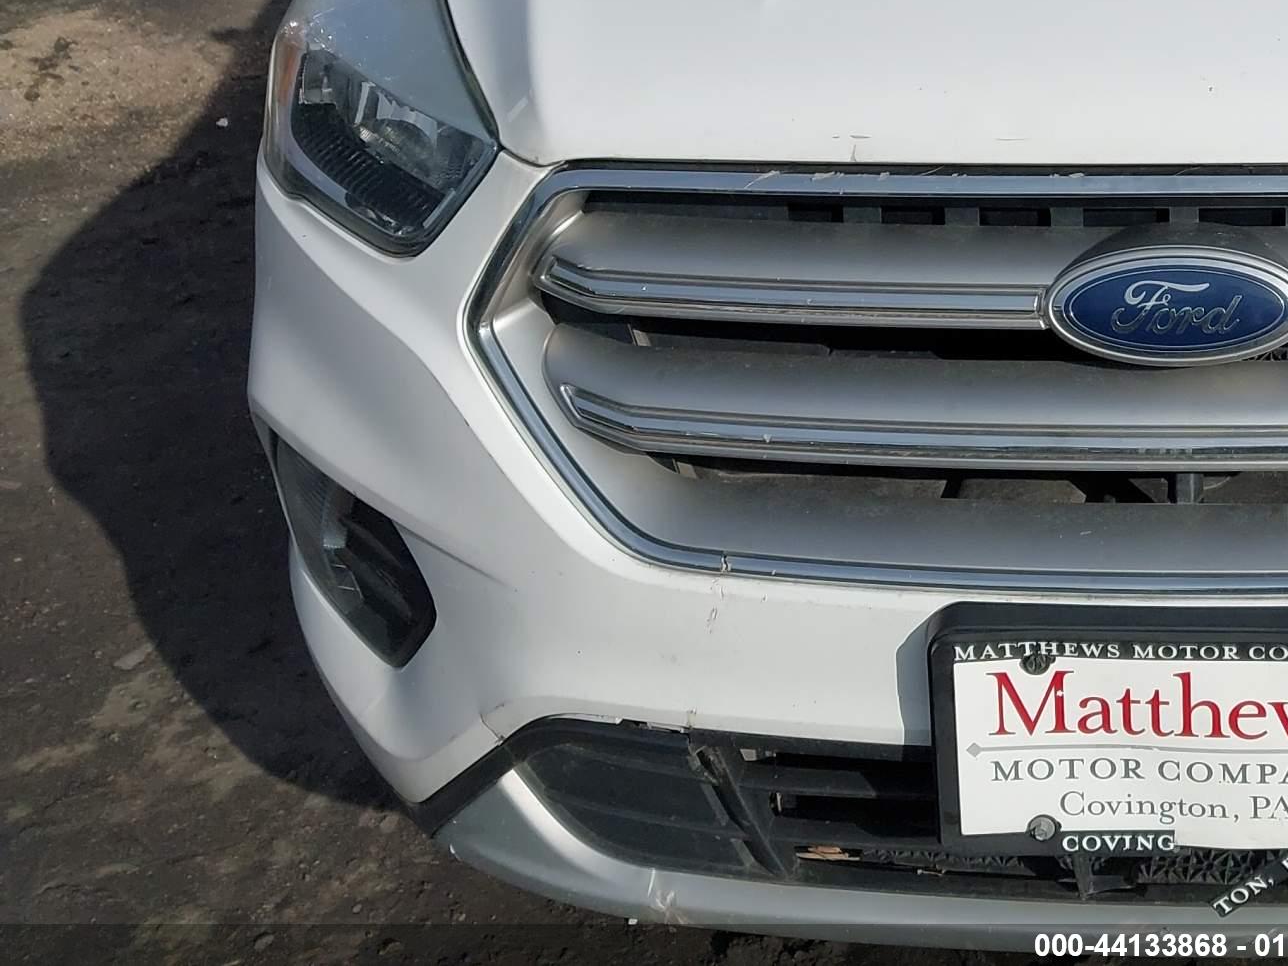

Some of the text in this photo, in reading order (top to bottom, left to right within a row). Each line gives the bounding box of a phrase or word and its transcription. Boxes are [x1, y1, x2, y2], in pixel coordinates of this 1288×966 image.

[1111, 280, 1243, 335] Ford
[954, 641, 1121, 661] MATTHEWS
[1133, 644, 1240, 660] MOTOR
[991, 757, 1146, 782] MOTOR
[1059, 790, 1239, 825] Covington,
[1062, 834, 1175, 852] COVING
[1213, 875, 1275, 915] TON,
